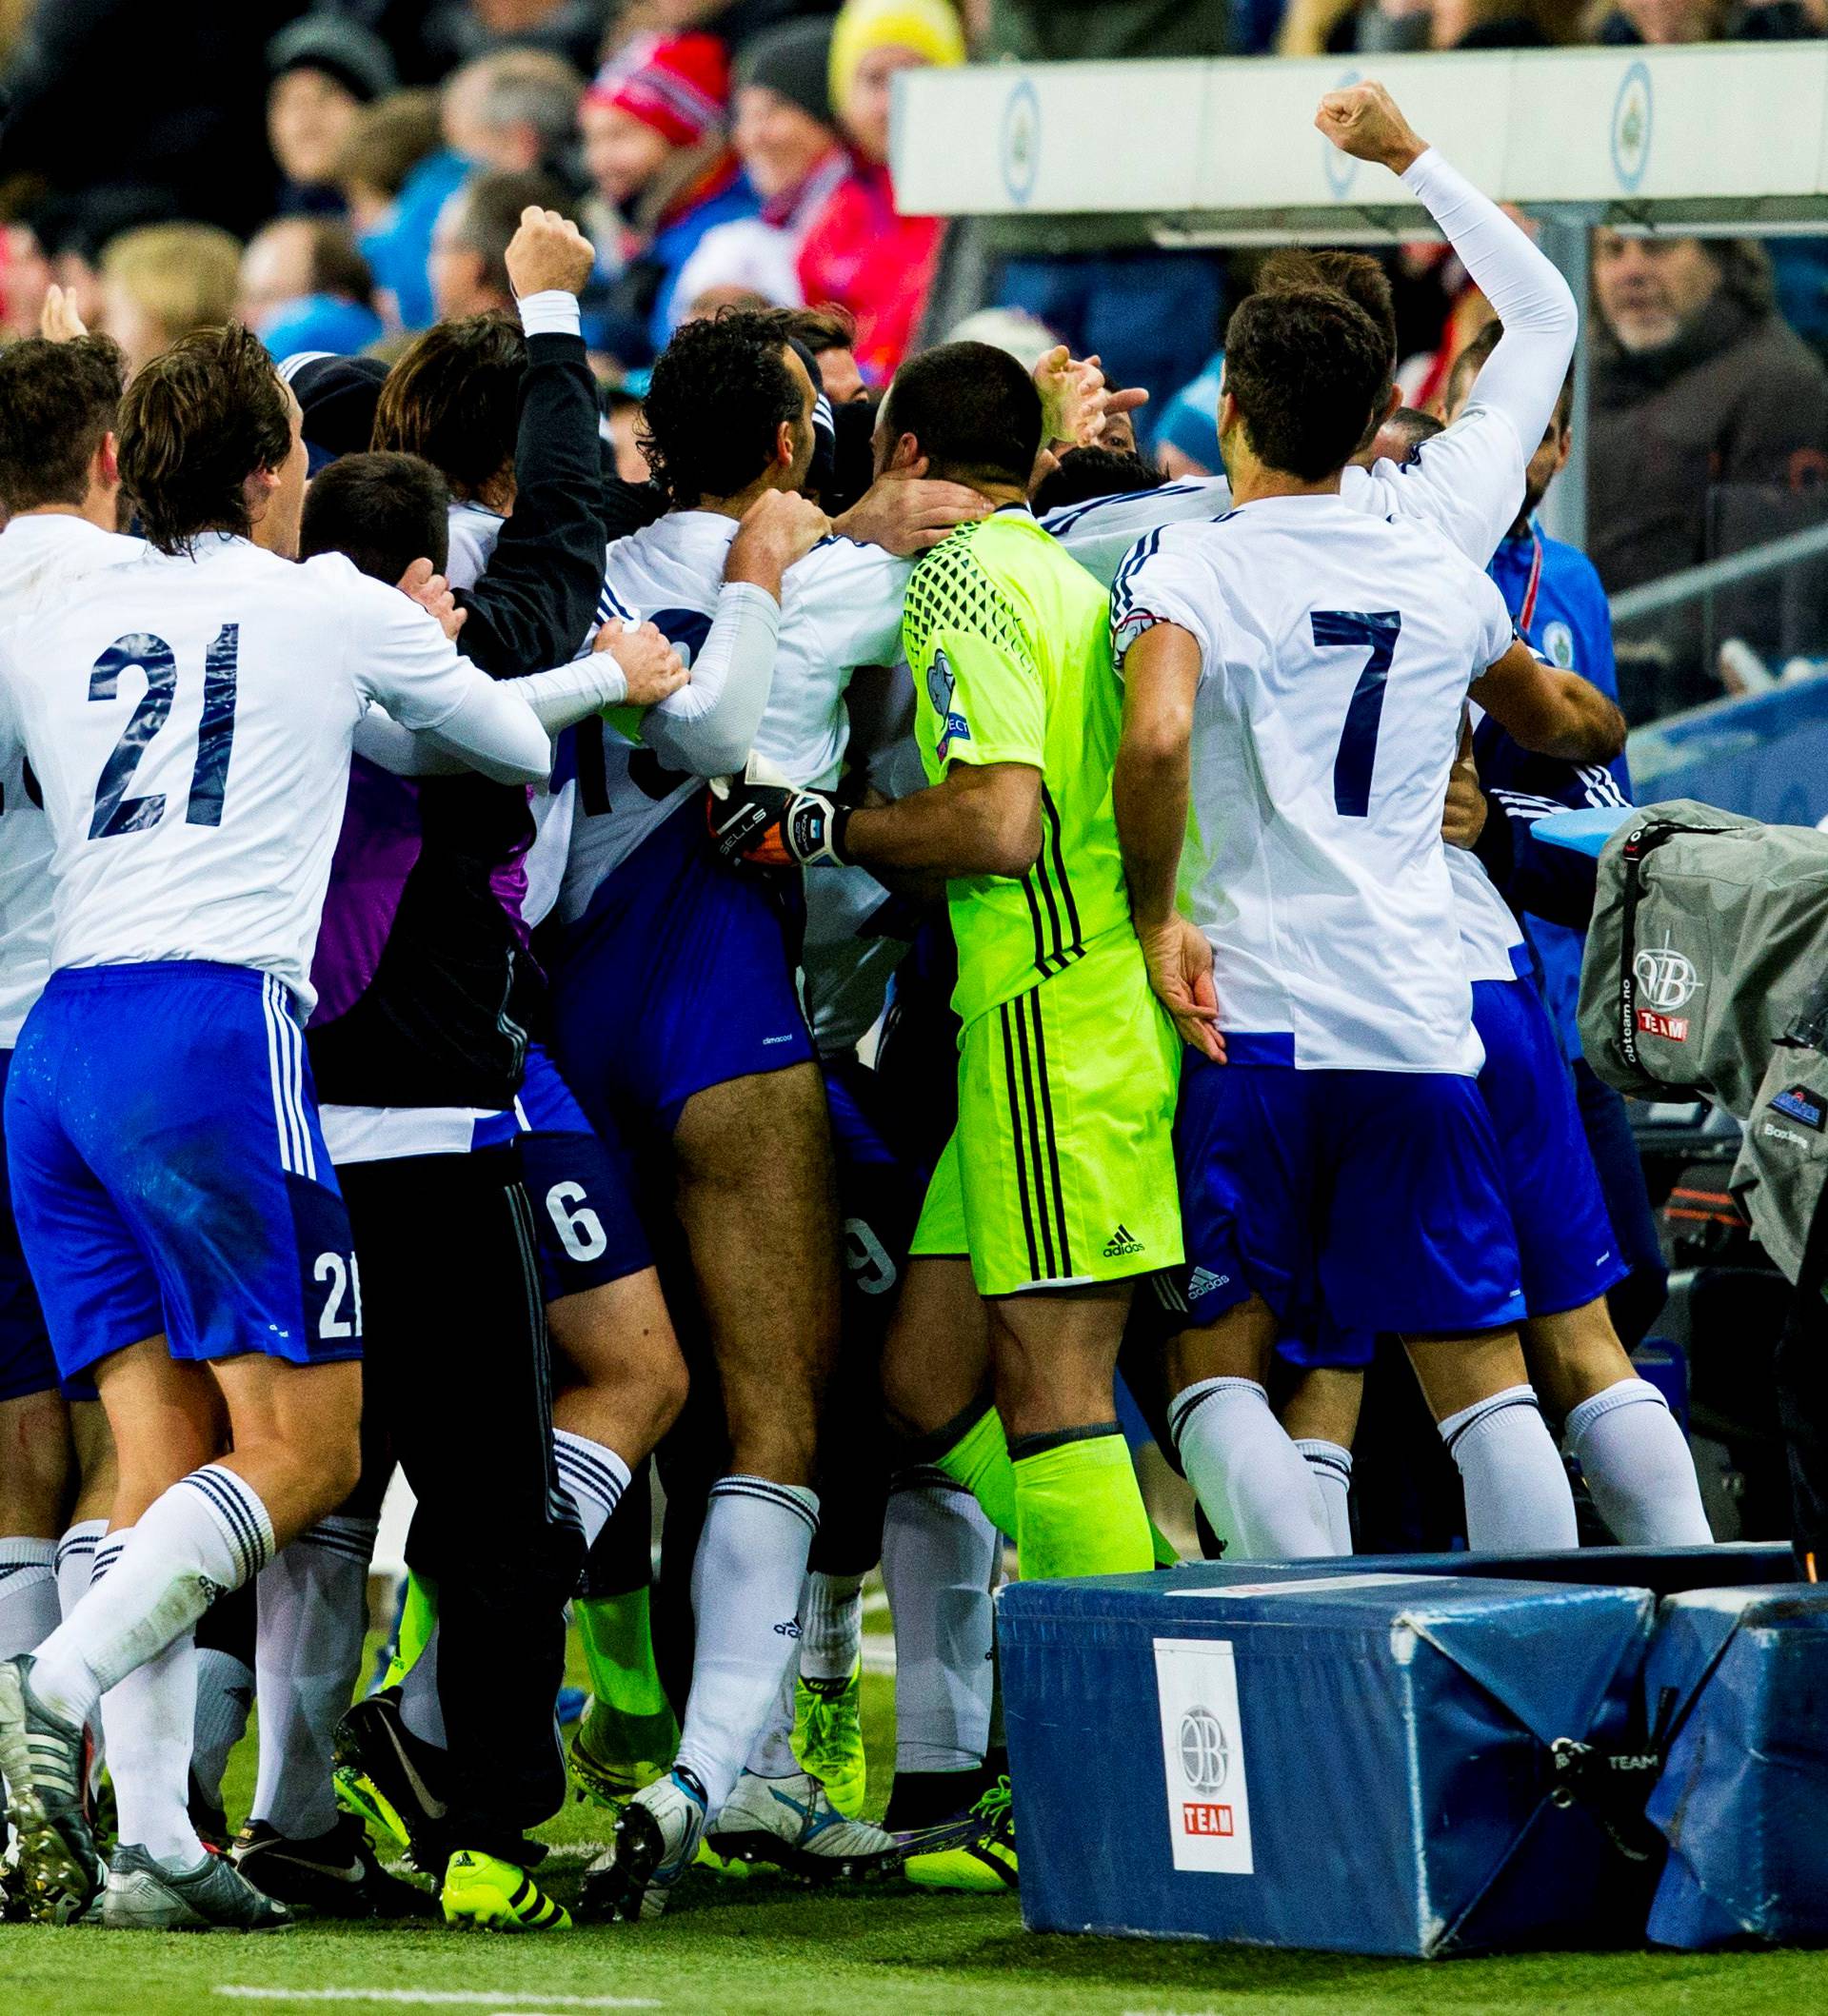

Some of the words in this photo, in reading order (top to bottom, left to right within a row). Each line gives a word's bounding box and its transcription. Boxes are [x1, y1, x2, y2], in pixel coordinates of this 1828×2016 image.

[1310, 610, 1401, 817] 7
[88, 623, 239, 840] 21
[720, 808, 766, 855] SELLS
[1640, 1012, 1685, 1039] TEAM
[546, 1180, 607, 1262] 6
[1103, 1242, 1145, 1257] adidas
[1188, 1275, 1230, 1300] adidas
[1609, 1755, 1659, 1769] TEAM
[1183, 1806, 1232, 1834] TEAM
